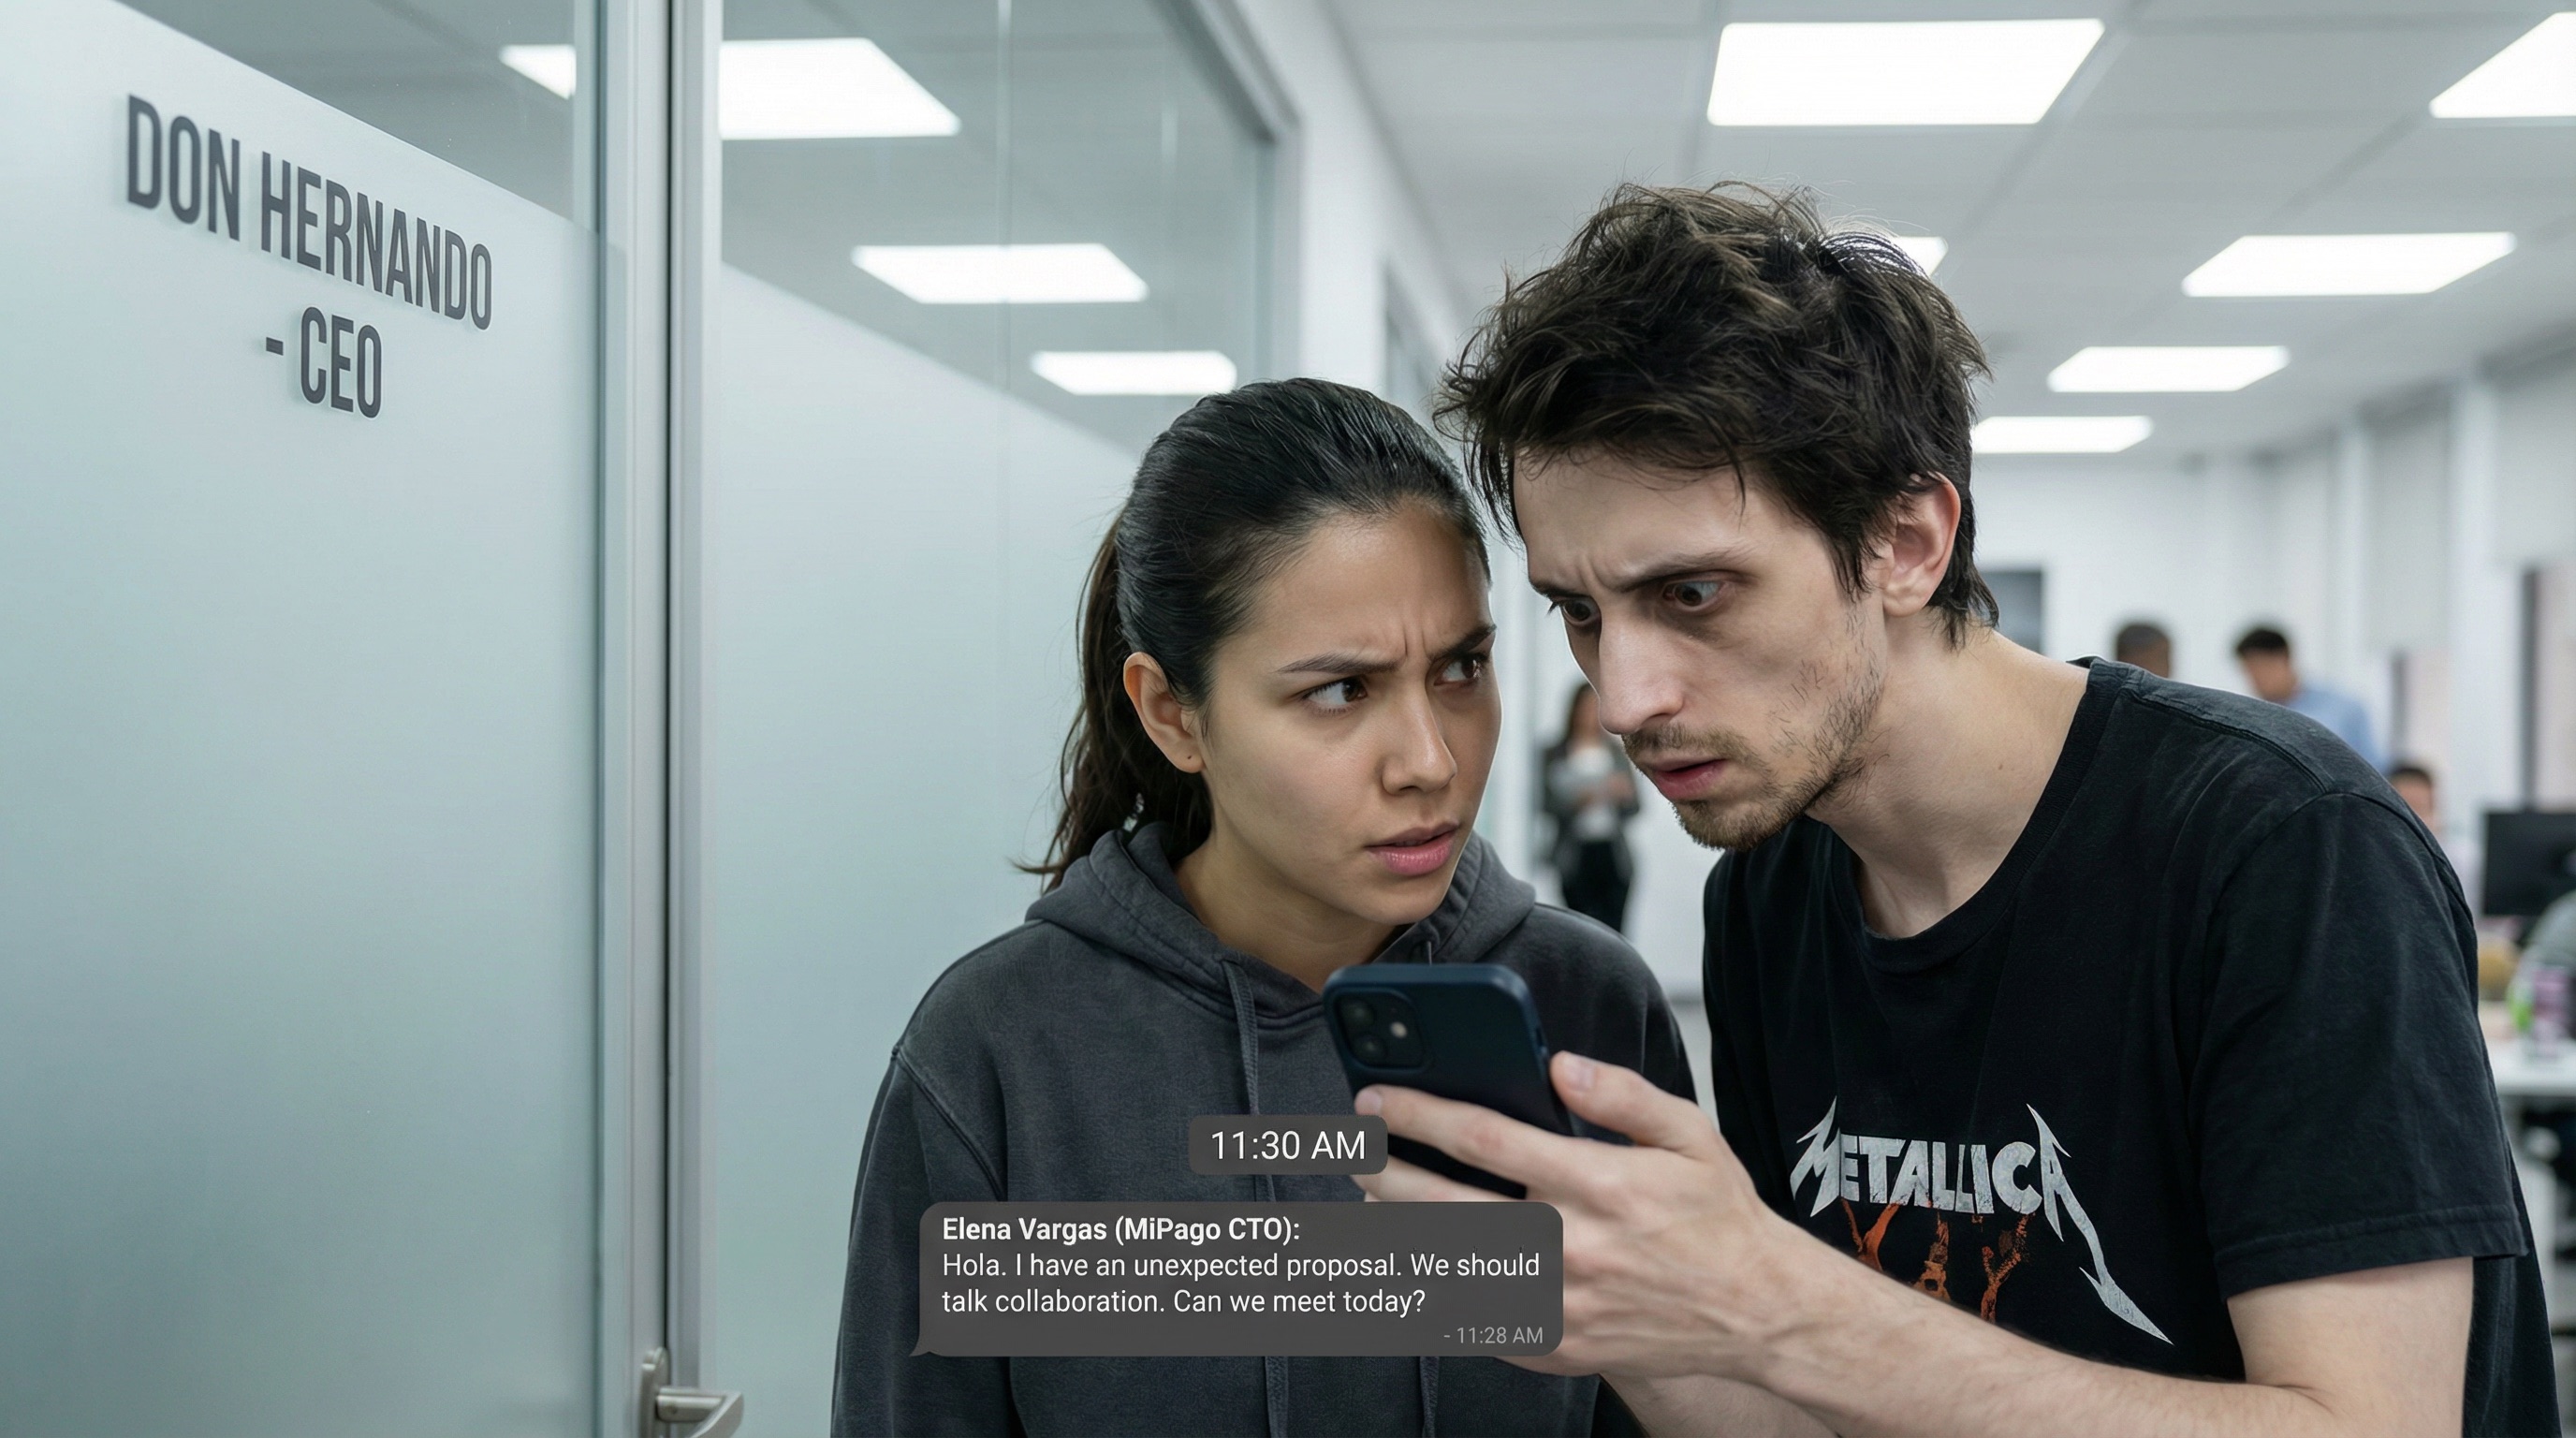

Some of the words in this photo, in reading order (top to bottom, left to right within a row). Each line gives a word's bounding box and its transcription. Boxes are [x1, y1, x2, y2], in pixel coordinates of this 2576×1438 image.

[127, 94, 240, 242] DON
[261, 151, 493, 331] HERNANDO
[300, 306, 382, 419] CEO
[1790, 1095, 2174, 1345] METALLICA
